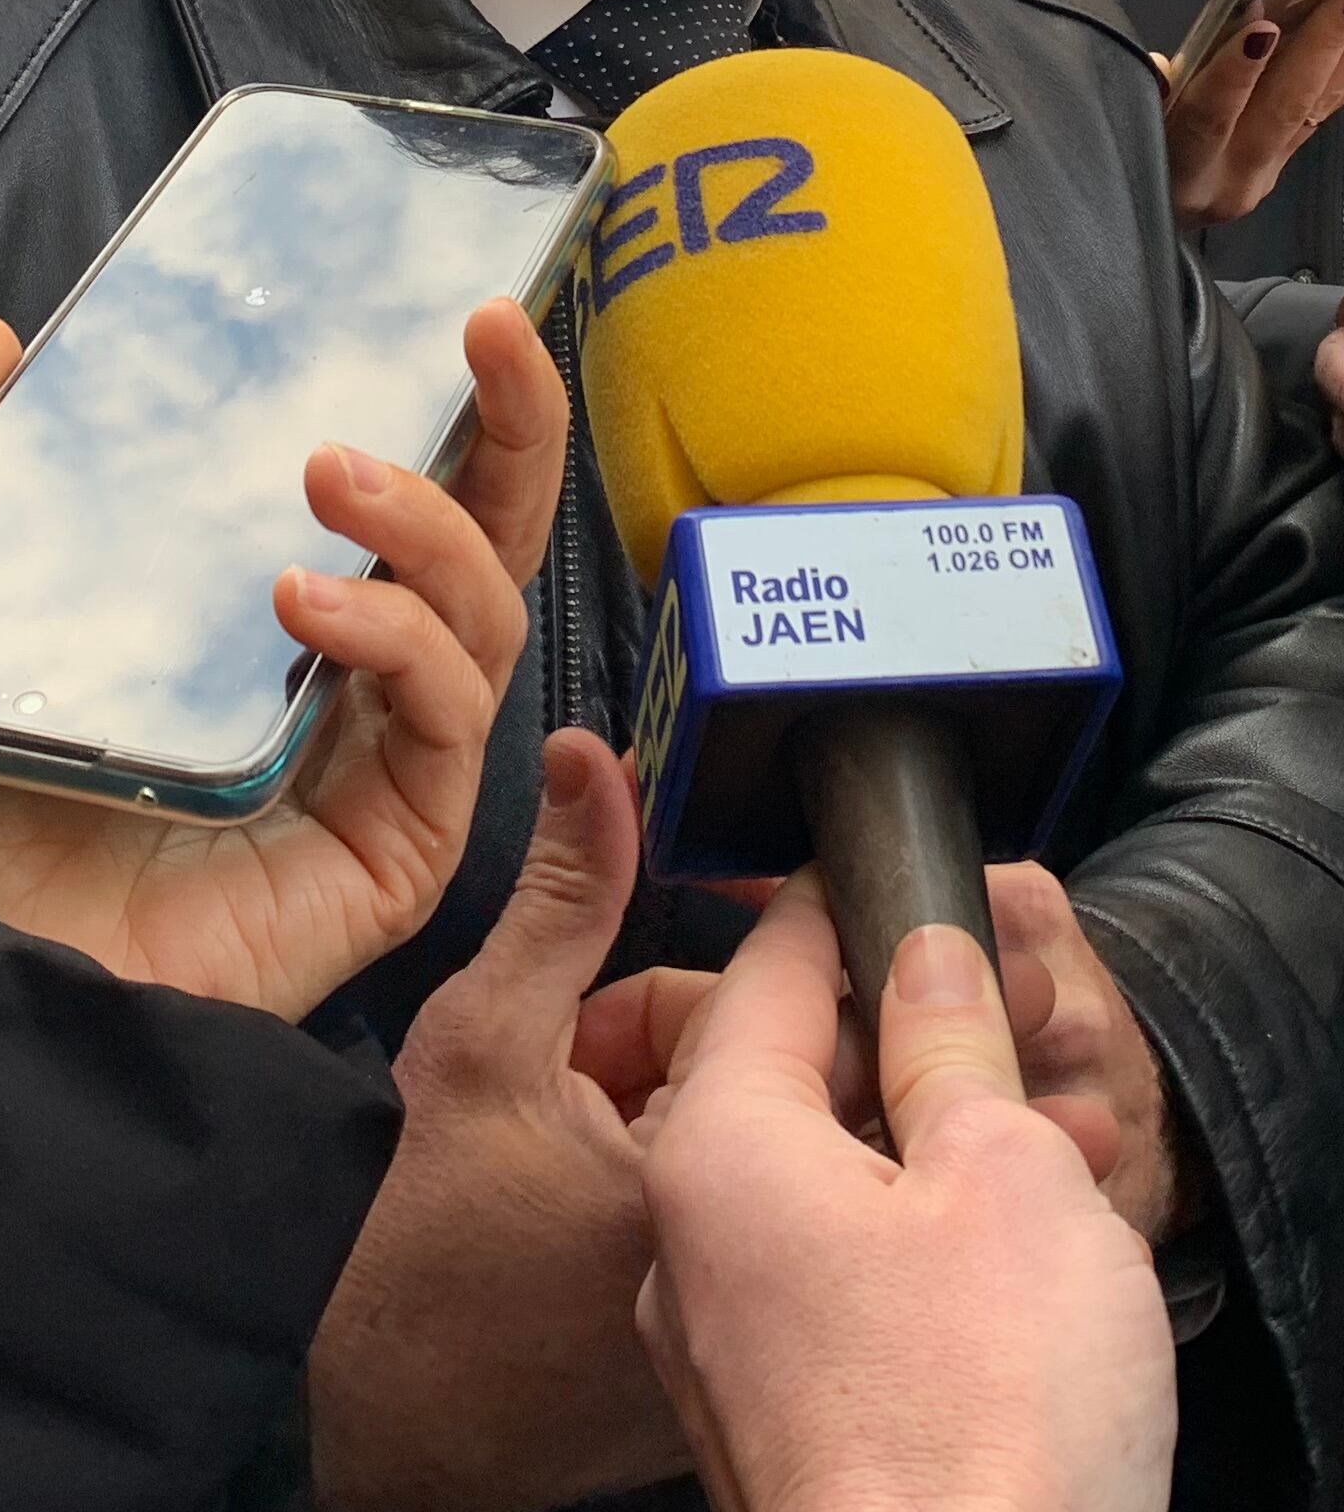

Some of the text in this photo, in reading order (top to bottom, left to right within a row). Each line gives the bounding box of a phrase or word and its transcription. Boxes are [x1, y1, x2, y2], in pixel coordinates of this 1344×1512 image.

[922, 520, 1045, 546] 100.0 FM
[927, 547, 1055, 574] 1.026 OM
[730, 566, 850, 605] Radio
[741, 607, 867, 648] JAEN
